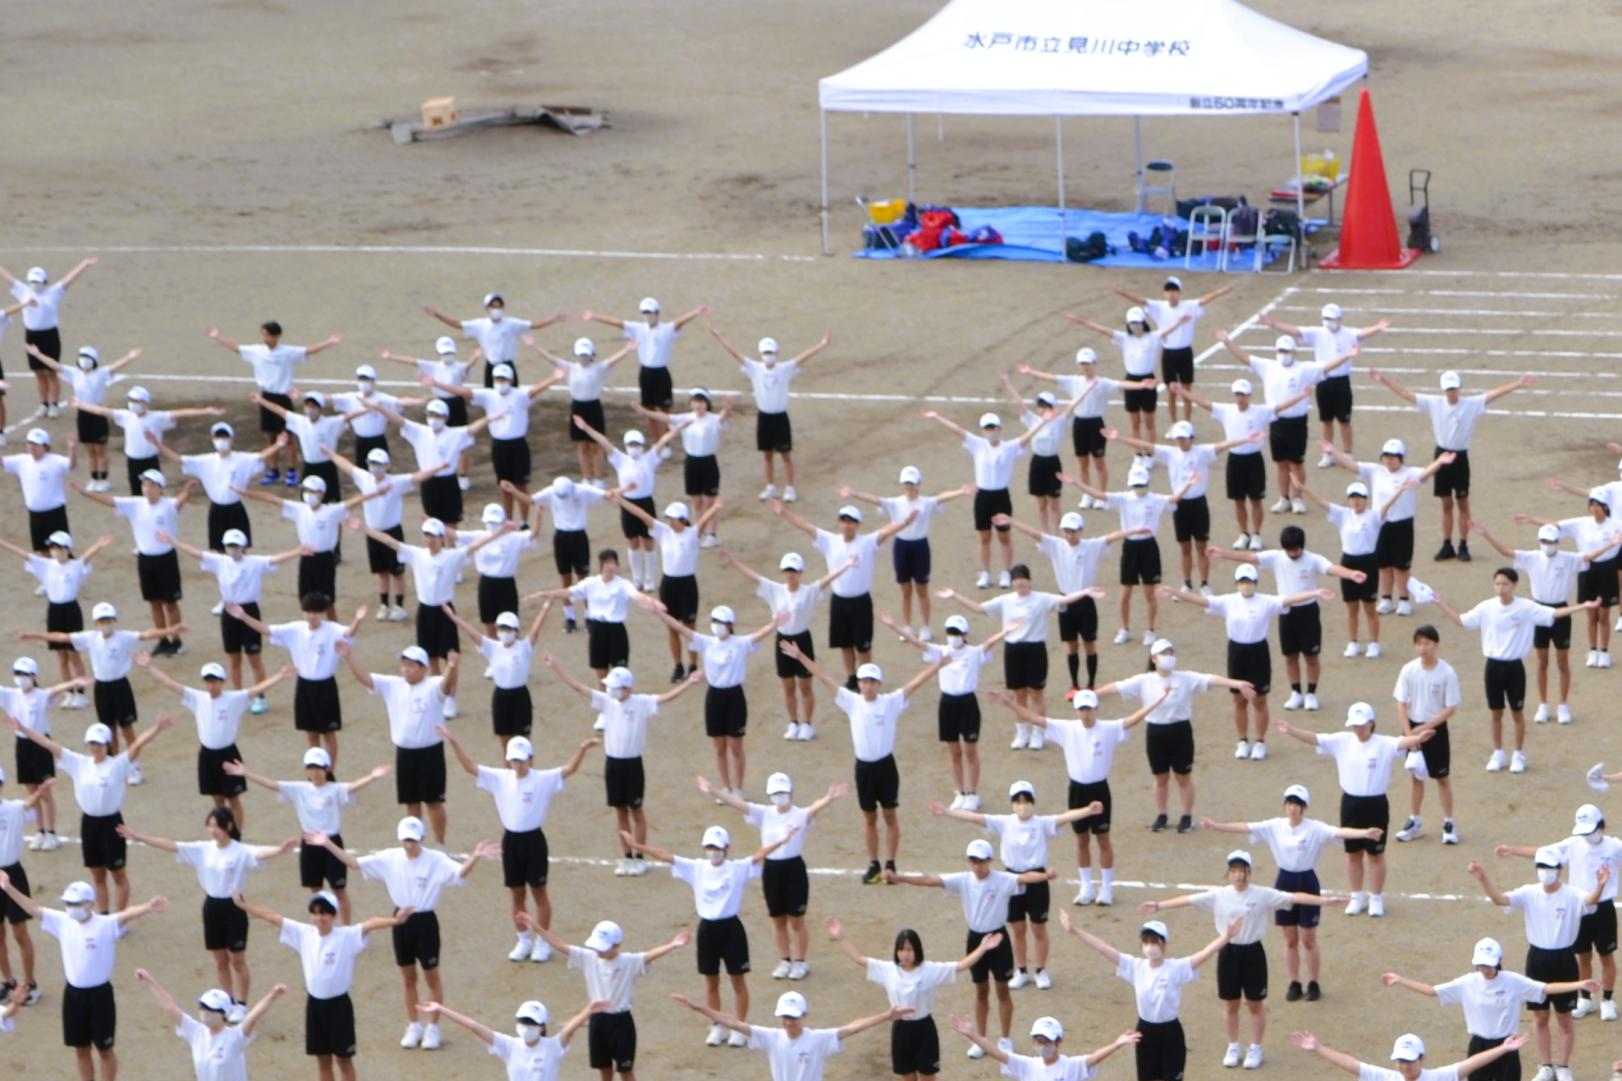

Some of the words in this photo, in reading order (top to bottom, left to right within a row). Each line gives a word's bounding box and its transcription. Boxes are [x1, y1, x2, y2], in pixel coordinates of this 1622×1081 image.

[963, 32, 1190, 57] 水戸市立見川中学校
